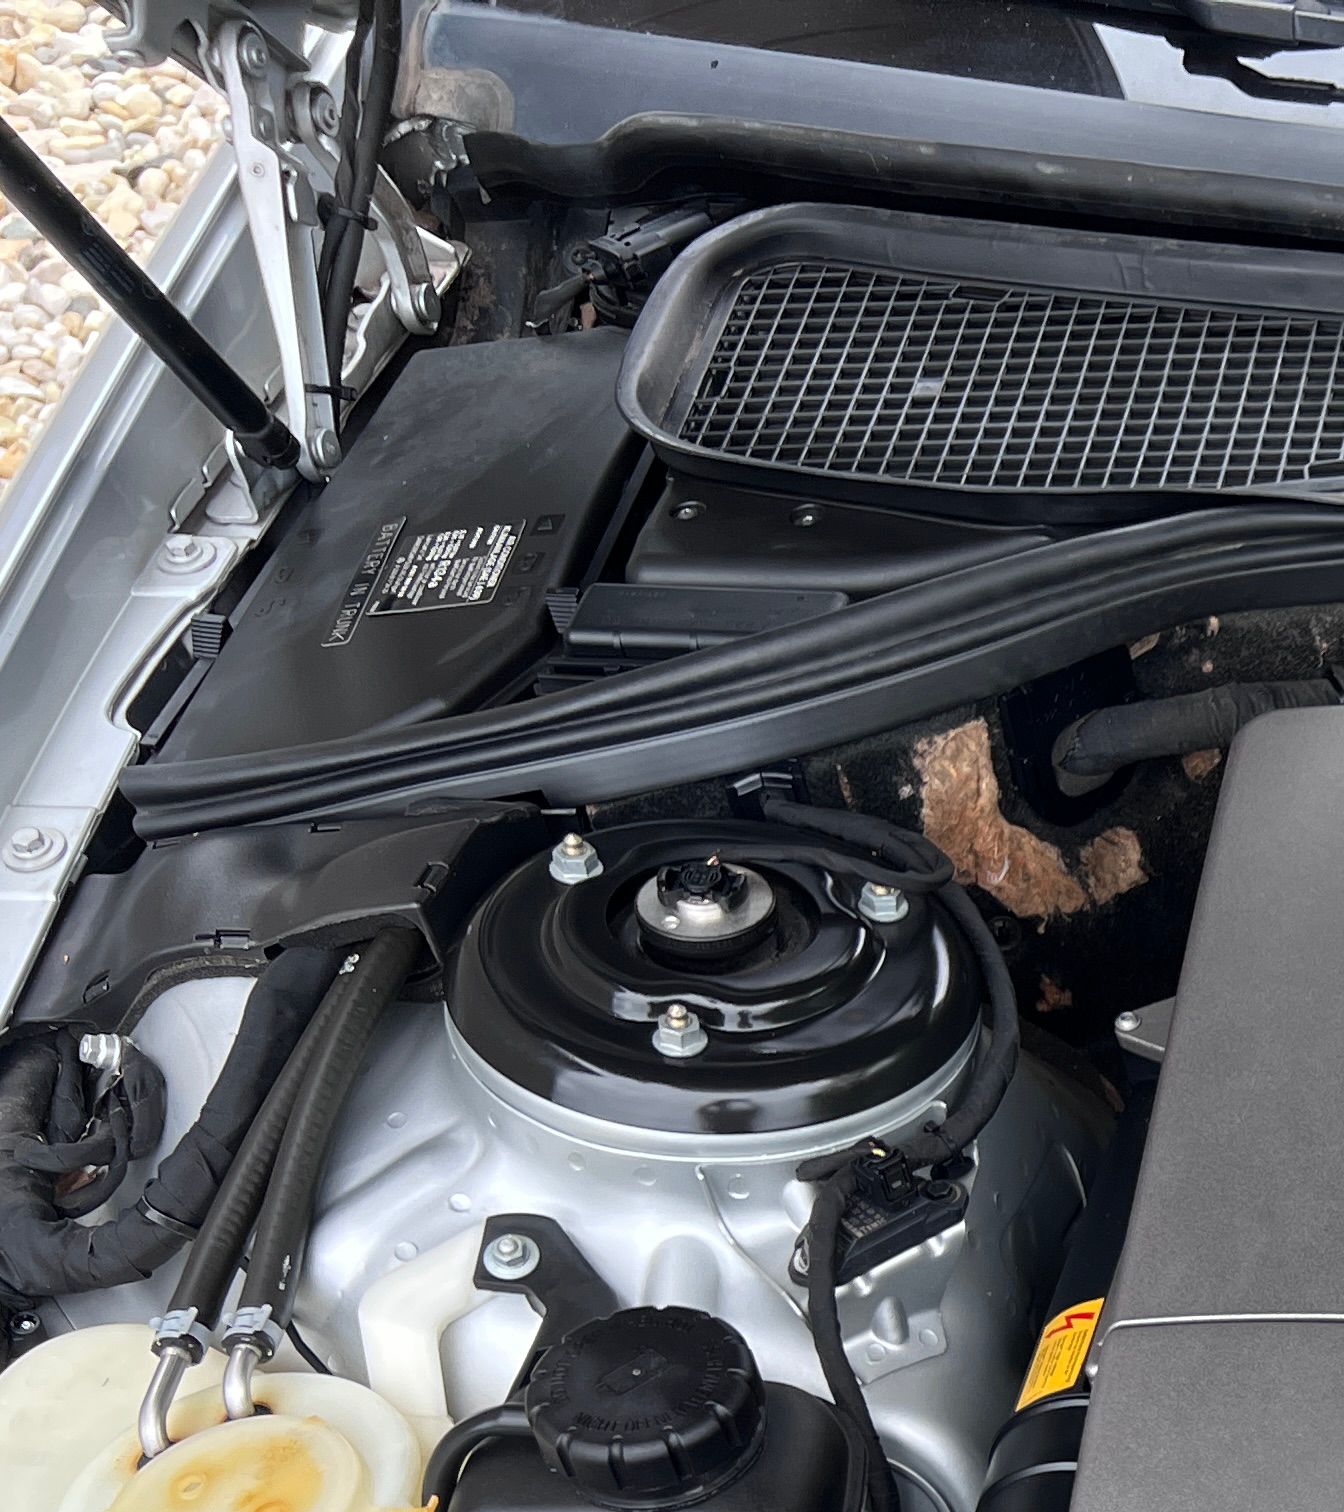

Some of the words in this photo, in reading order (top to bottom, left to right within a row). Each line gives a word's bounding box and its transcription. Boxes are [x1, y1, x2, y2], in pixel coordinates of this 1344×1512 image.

[362, 523, 399, 575] BATTERY
[349, 583, 370, 596] IN
[329, 602, 361, 642] TRUNK
